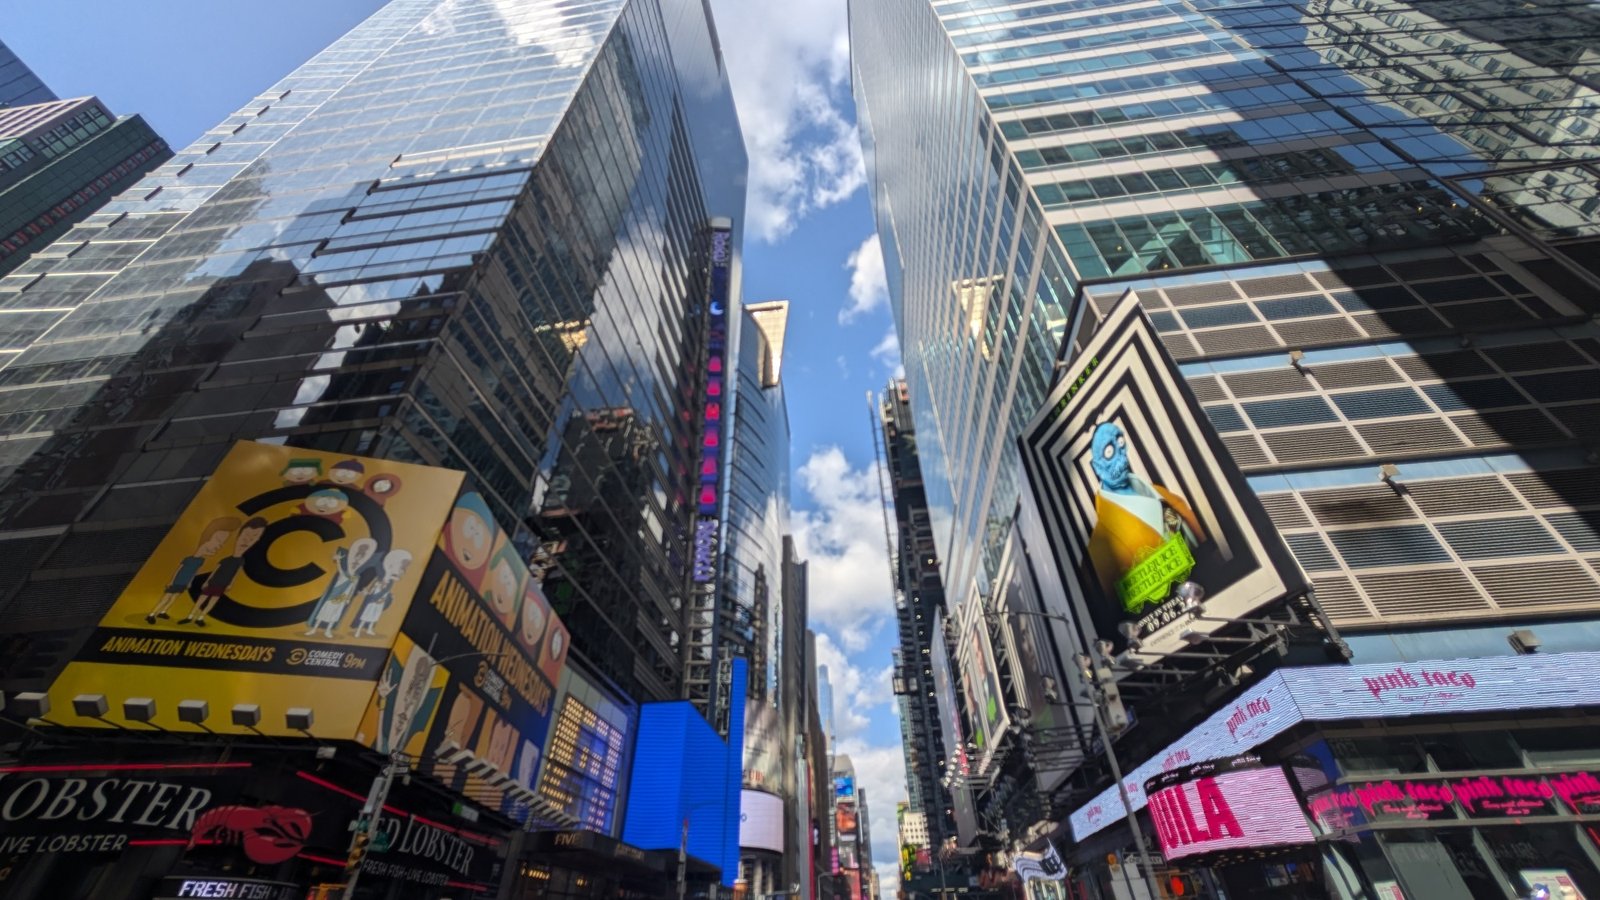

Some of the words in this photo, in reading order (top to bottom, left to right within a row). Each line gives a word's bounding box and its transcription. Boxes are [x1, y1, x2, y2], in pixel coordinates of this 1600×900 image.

[430, 570, 504, 665] ANIMATION
[1147, 602, 1187, 632] 09.06.2
[102, 636, 184, 656] ANIMATION
[183, 640, 276, 662] WEDNESDAYS
[308, 649, 345, 660] COMEDY
[343, 653, 367, 669] 9PM
[304, 657, 341, 668] CENTRAL
[0, 773, 212, 830] OBSTER
[0, 835, 37, 853] IVE
[36, 834, 128, 852] LOBSTER
[398, 814, 474, 877] LOBSTER
[361, 859, 388, 876] FRESH
[387, 863, 405, 879] FISH
[407, 868, 423, 882] LIVE
[421, 870, 450, 886] LOBSTER
[177, 880, 239, 898] FRESH
[238, 883, 273, 900] FISH
